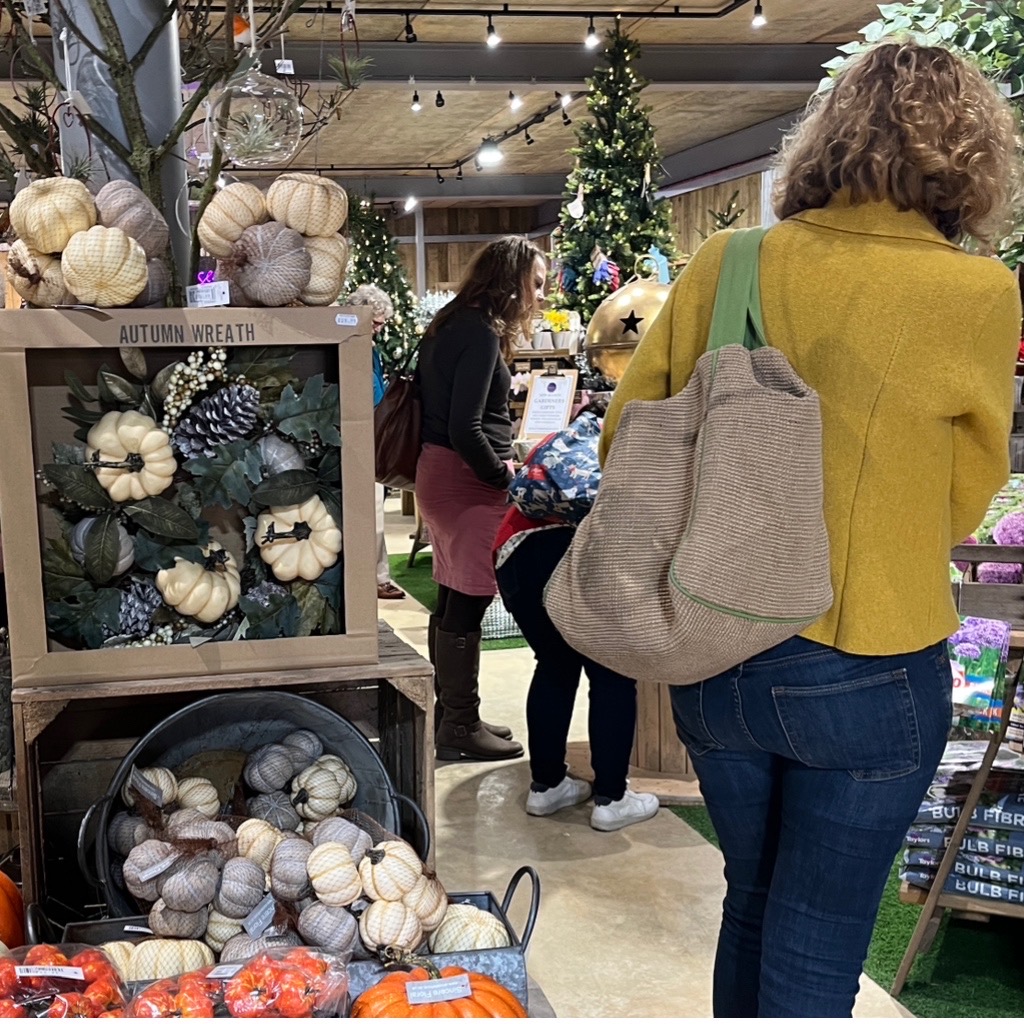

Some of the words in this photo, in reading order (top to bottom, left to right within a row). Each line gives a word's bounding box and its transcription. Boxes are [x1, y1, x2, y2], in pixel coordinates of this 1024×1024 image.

[120, 324, 184, 344] AUTUMN
[191, 323, 255, 343] WREATH
[954, 862, 1001, 881] BULB
[955, 879, 1002, 898] BULB
